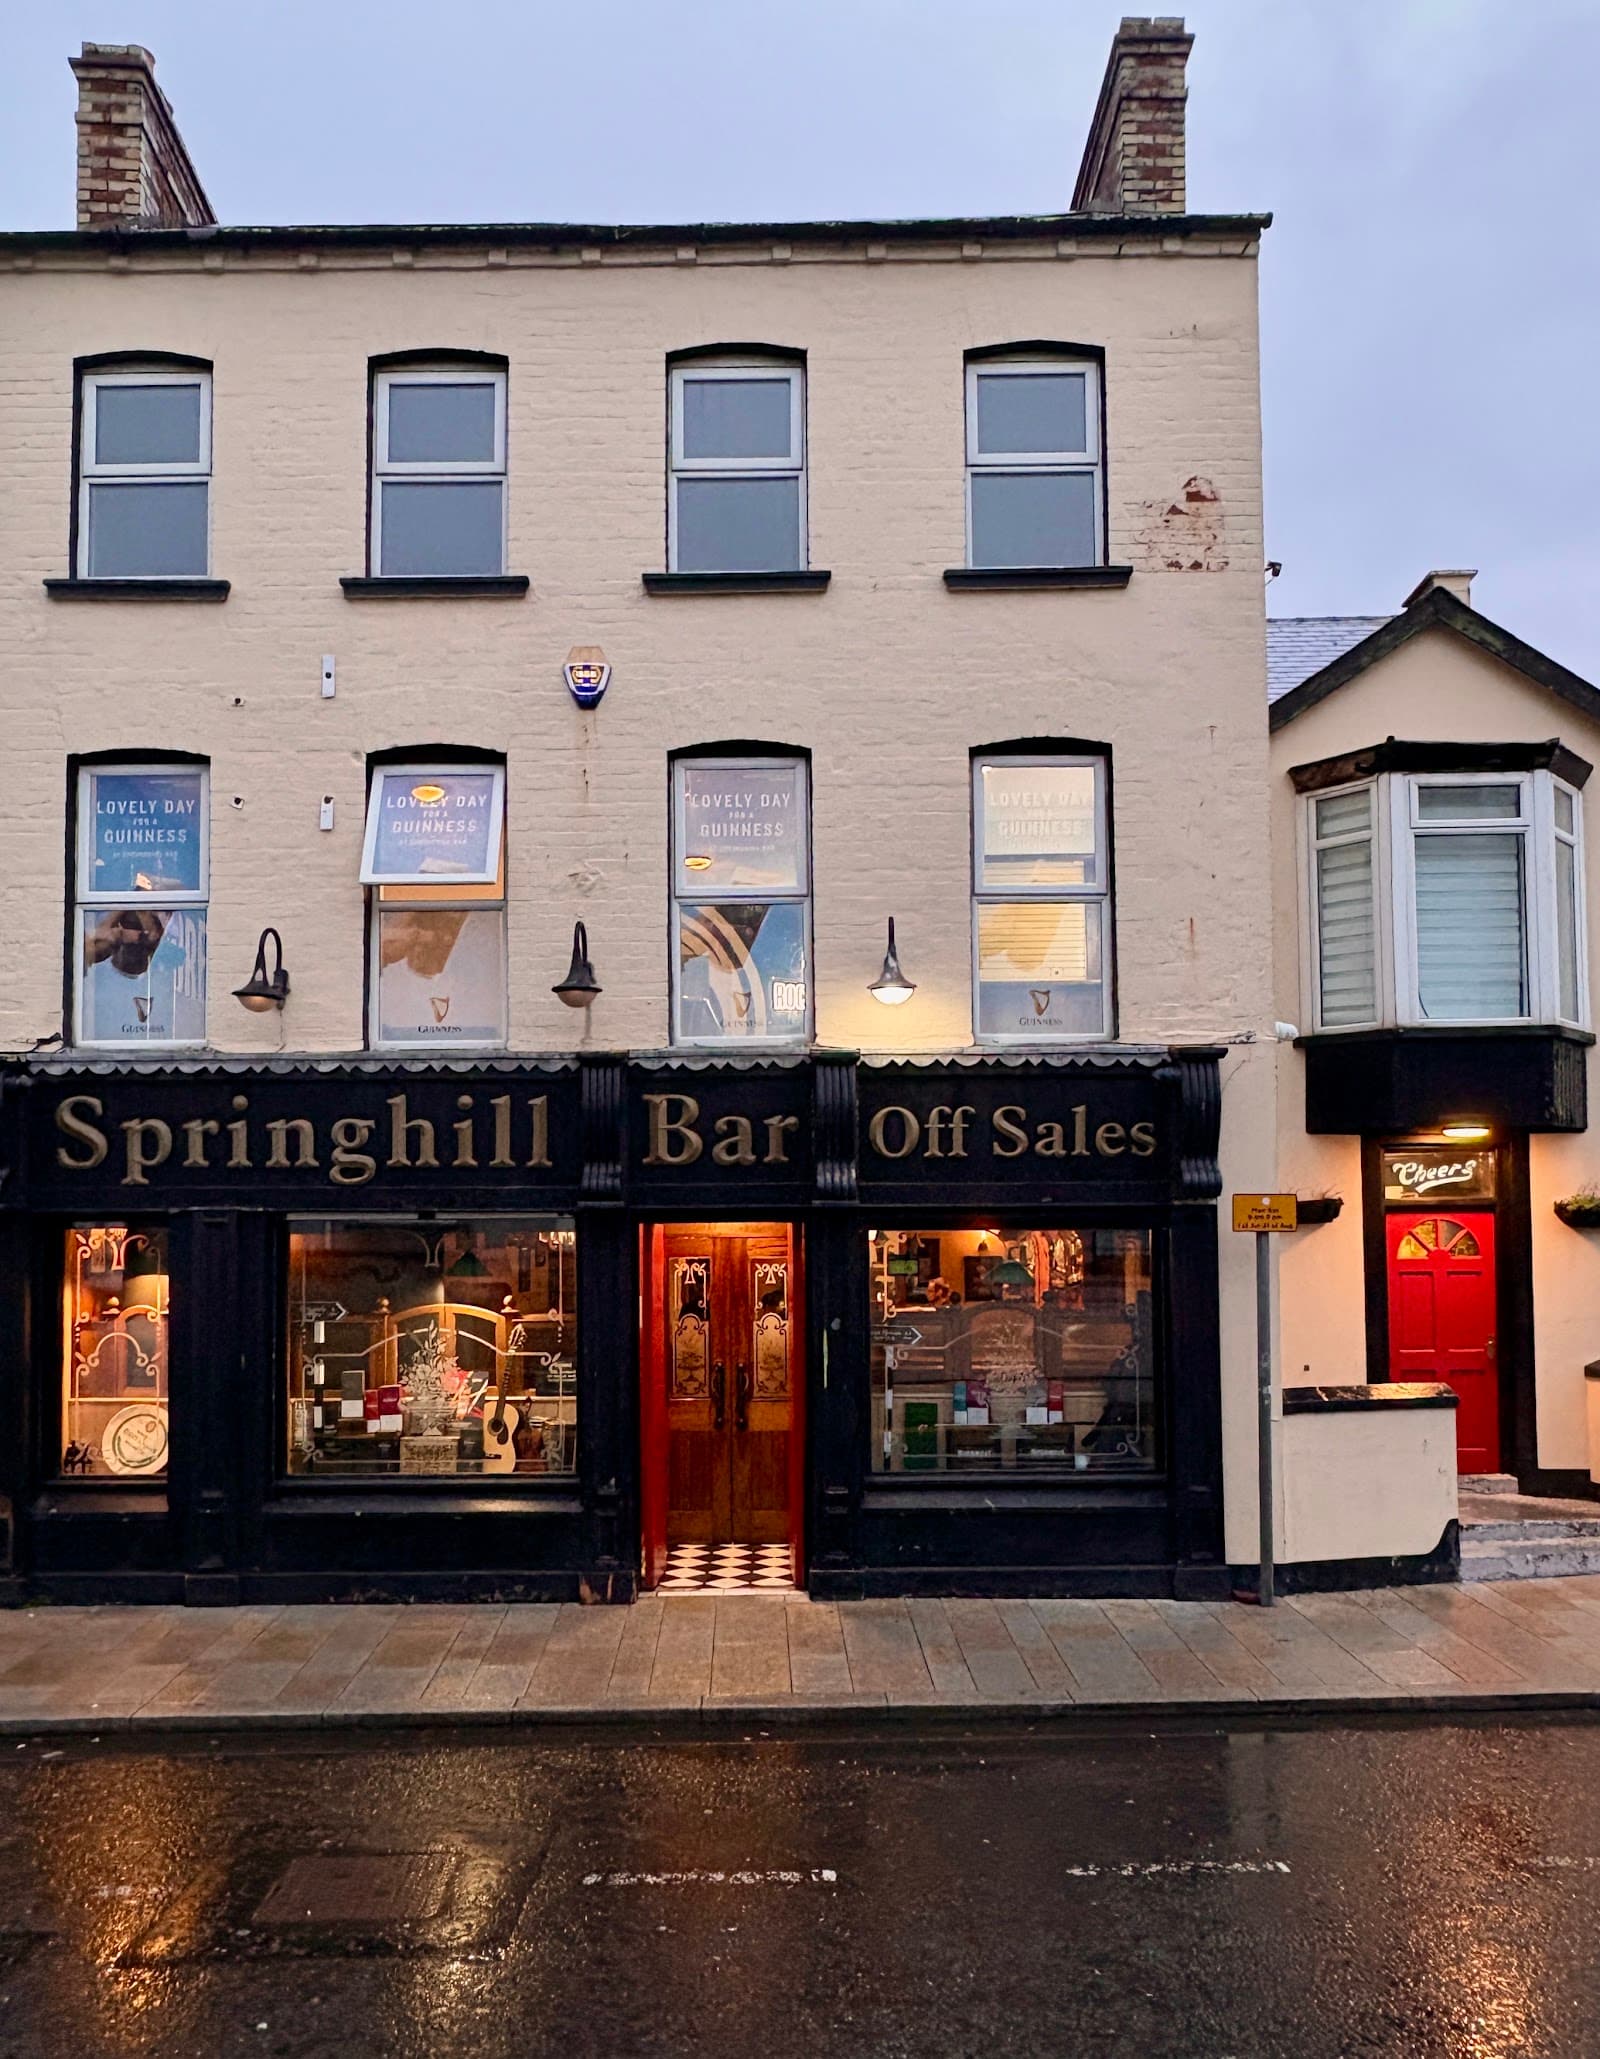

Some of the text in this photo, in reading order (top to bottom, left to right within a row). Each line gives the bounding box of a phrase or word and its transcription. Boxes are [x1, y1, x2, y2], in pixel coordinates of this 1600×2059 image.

[456, 795, 487, 808] DAY
[690, 792, 790, 808] LOVELY DAY
[989, 791, 1052, 807] LOVELY
[97, 800, 195, 814] LOVELY DAY
[392, 819, 477, 833] GUINNESS
[700, 823, 784, 837] GUINNESS
[104, 829, 187, 843] GUINNESS
[55, 1093, 1158, 1185] Springhill Bar Off Sales
[1392, 1160, 1477, 1187] Cheers
